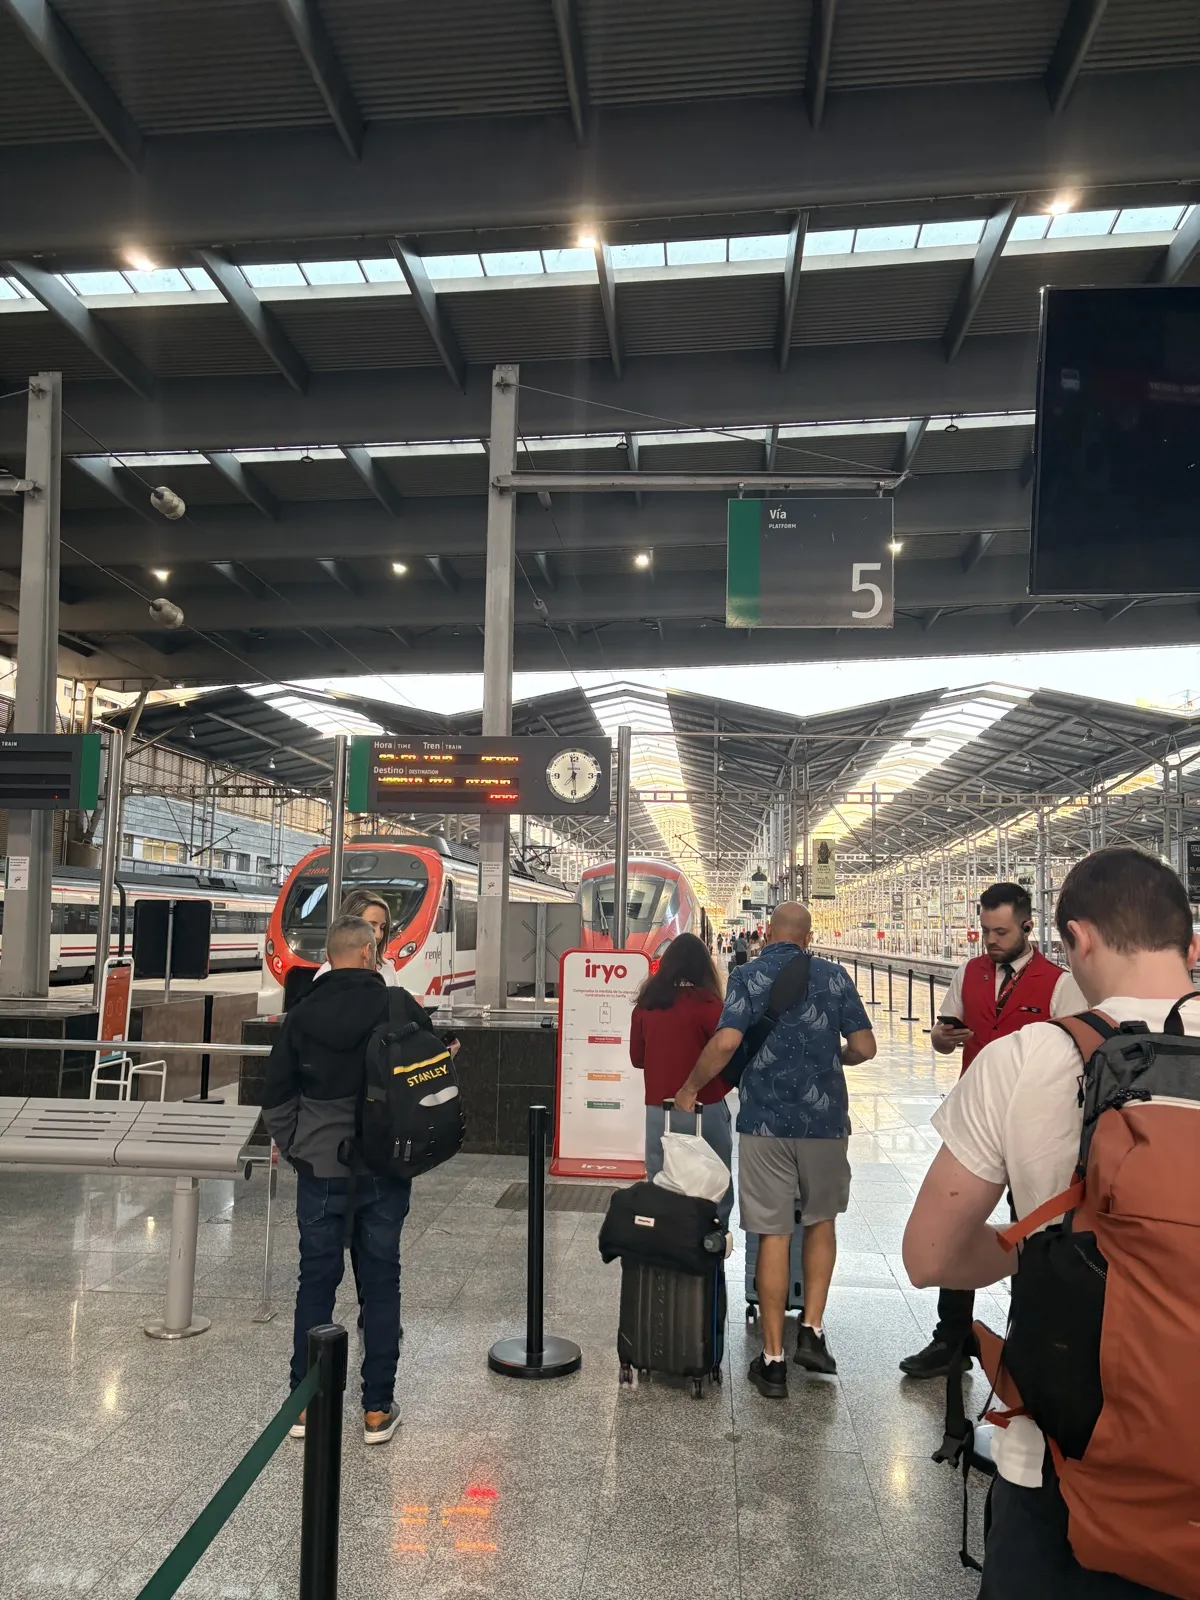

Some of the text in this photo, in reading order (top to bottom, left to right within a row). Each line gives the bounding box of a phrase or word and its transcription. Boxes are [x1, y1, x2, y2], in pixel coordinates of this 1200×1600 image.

[769, 508, 787, 519] Vía
[851, 562, 883, 619] 5
[374, 741, 393, 749] Hora
[423, 741, 440, 749] Tren
[373, 766, 404, 774] Destino
[585, 958, 627, 984] iryo
[406, 1064, 449, 1087] STANLEY
